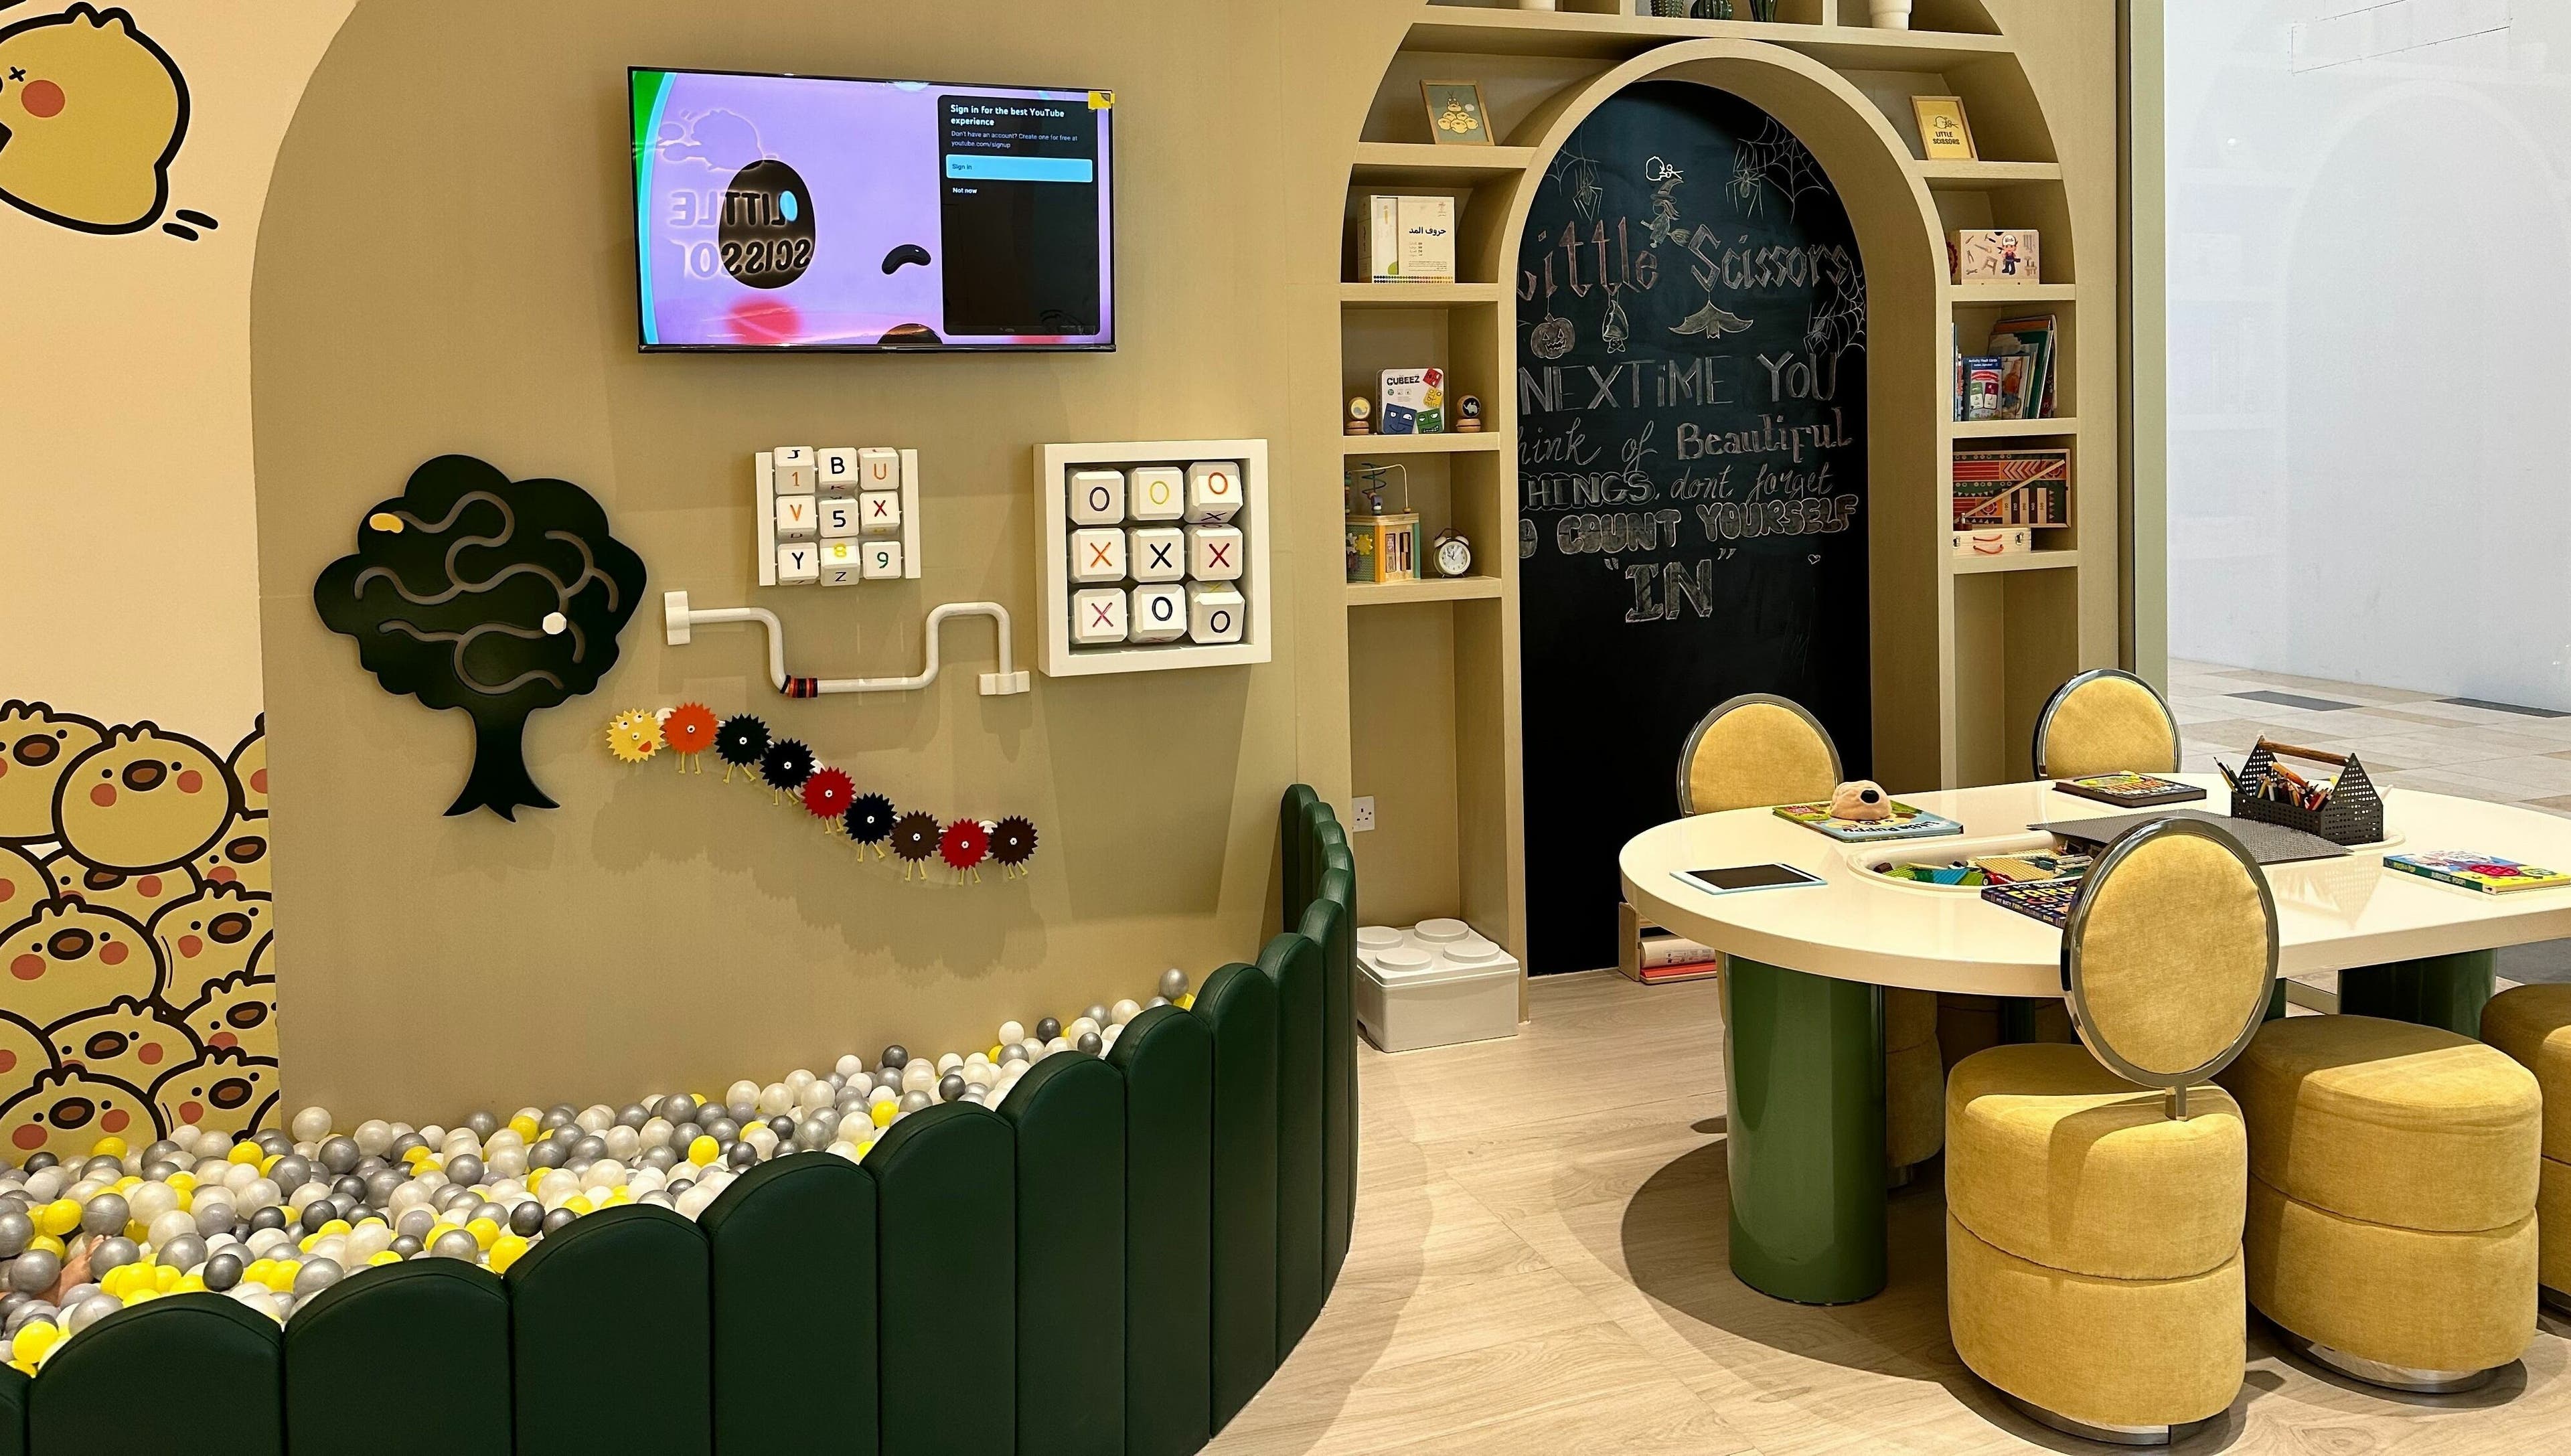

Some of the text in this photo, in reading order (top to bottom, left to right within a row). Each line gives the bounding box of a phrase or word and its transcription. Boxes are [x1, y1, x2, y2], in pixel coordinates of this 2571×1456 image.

[950, 104, 1065, 117] Sign in for the best YouTube
[950, 117, 994, 127] experience
[951, 140, 1011, 149] youtube.com/signup
[1425, 228, 1447, 237] حروف
[1688, 224, 1849, 292] Scissors
[1387, 376, 1420, 386] CUBEEZ
[787, 450, 800, 459] J
[1518, 406, 1855, 478] hink of Beautiful
[792, 457, 886, 487] 1 B U
[1670, 464, 1735, 500] dont
[1746, 462, 1833, 507] forget
[1089, 472, 1228, 511] O O O
[790, 499, 887, 528] V 5 X
[1557, 509, 1681, 555] COUNT
[1696, 494, 1859, 542] YOURSELF
[791, 543, 889, 570] Y 8 9
[1090, 542, 1230, 569] X X X
[1091, 596, 1231, 633] X O O
